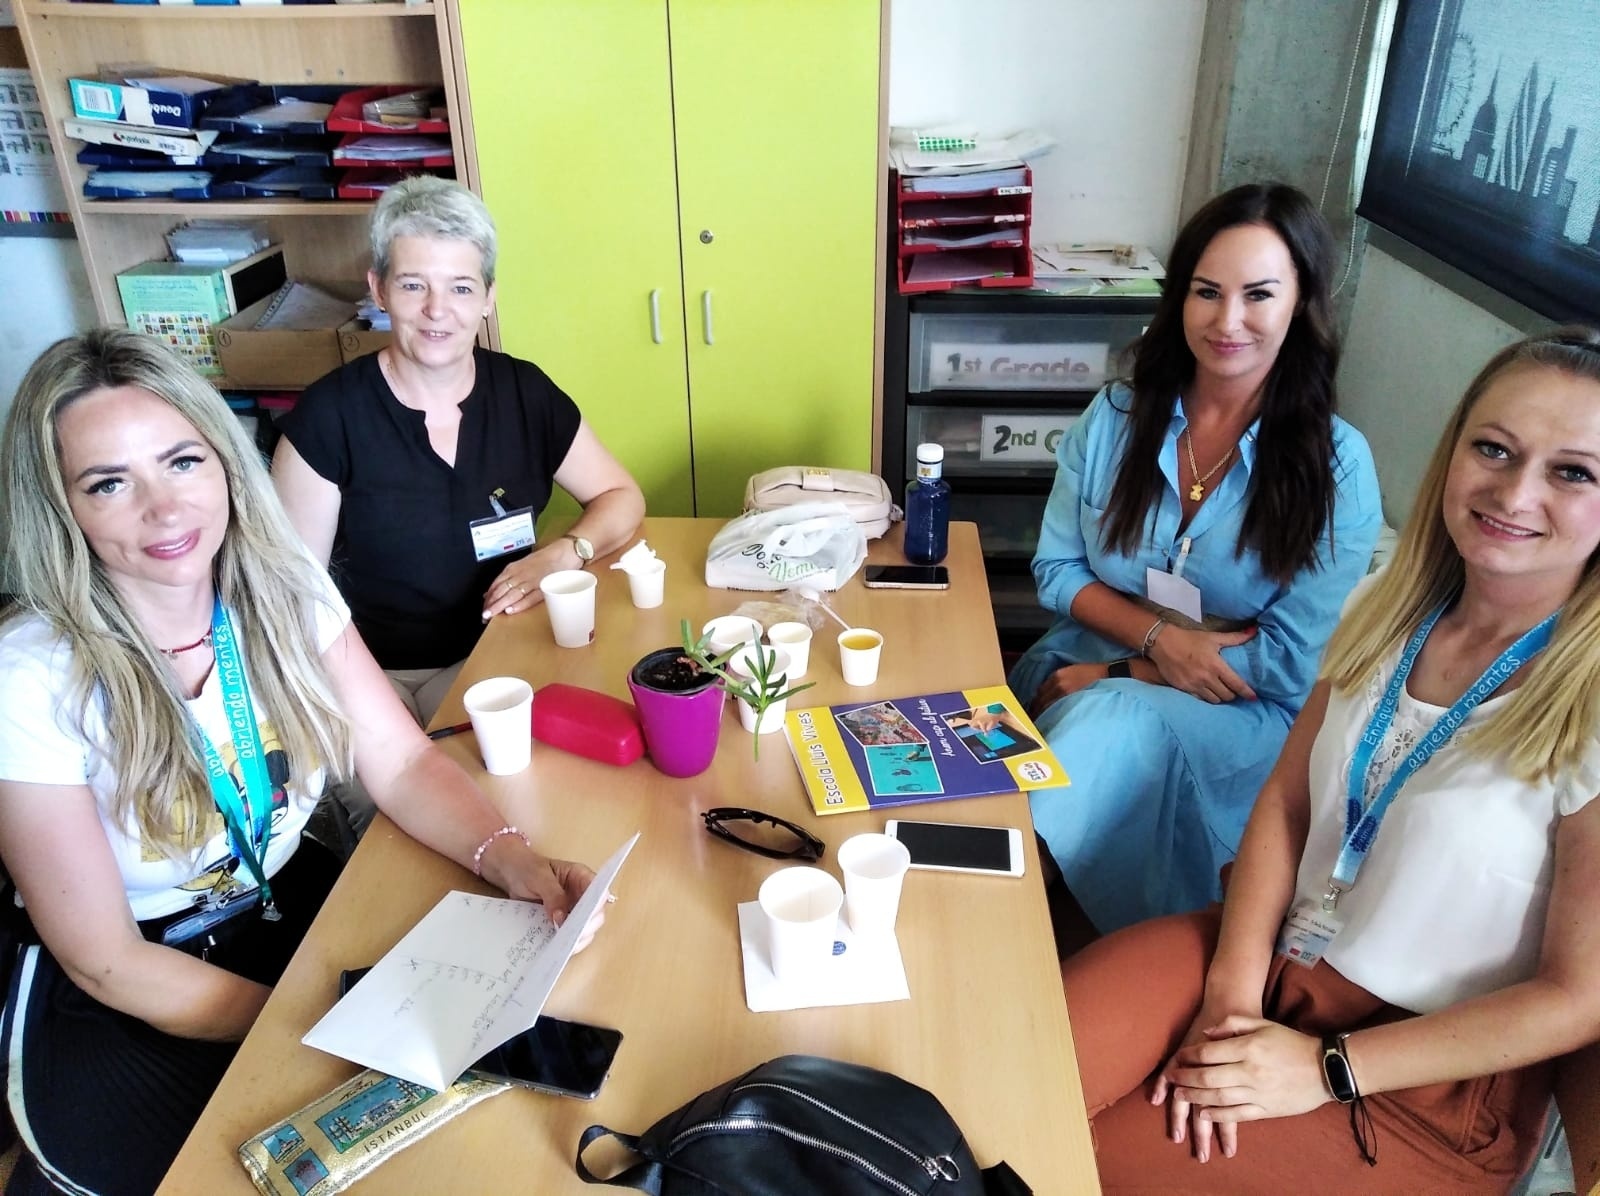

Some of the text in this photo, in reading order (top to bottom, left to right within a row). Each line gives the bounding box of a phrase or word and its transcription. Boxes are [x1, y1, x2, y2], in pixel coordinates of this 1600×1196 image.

[150, 103, 181, 117] Doub
[990, 357, 1090, 383] Grade
[993, 425, 1036, 454] 2nd
[1363, 658, 1410, 746] Enriqueciendo
[1408, 654, 1520, 768] abriendo mentes
[224, 693, 255, 759] abriendo
[799, 712, 817, 741] Vives
[818, 768, 843, 805] Escola
[363, 1110, 428, 1153] ISTANBUL
